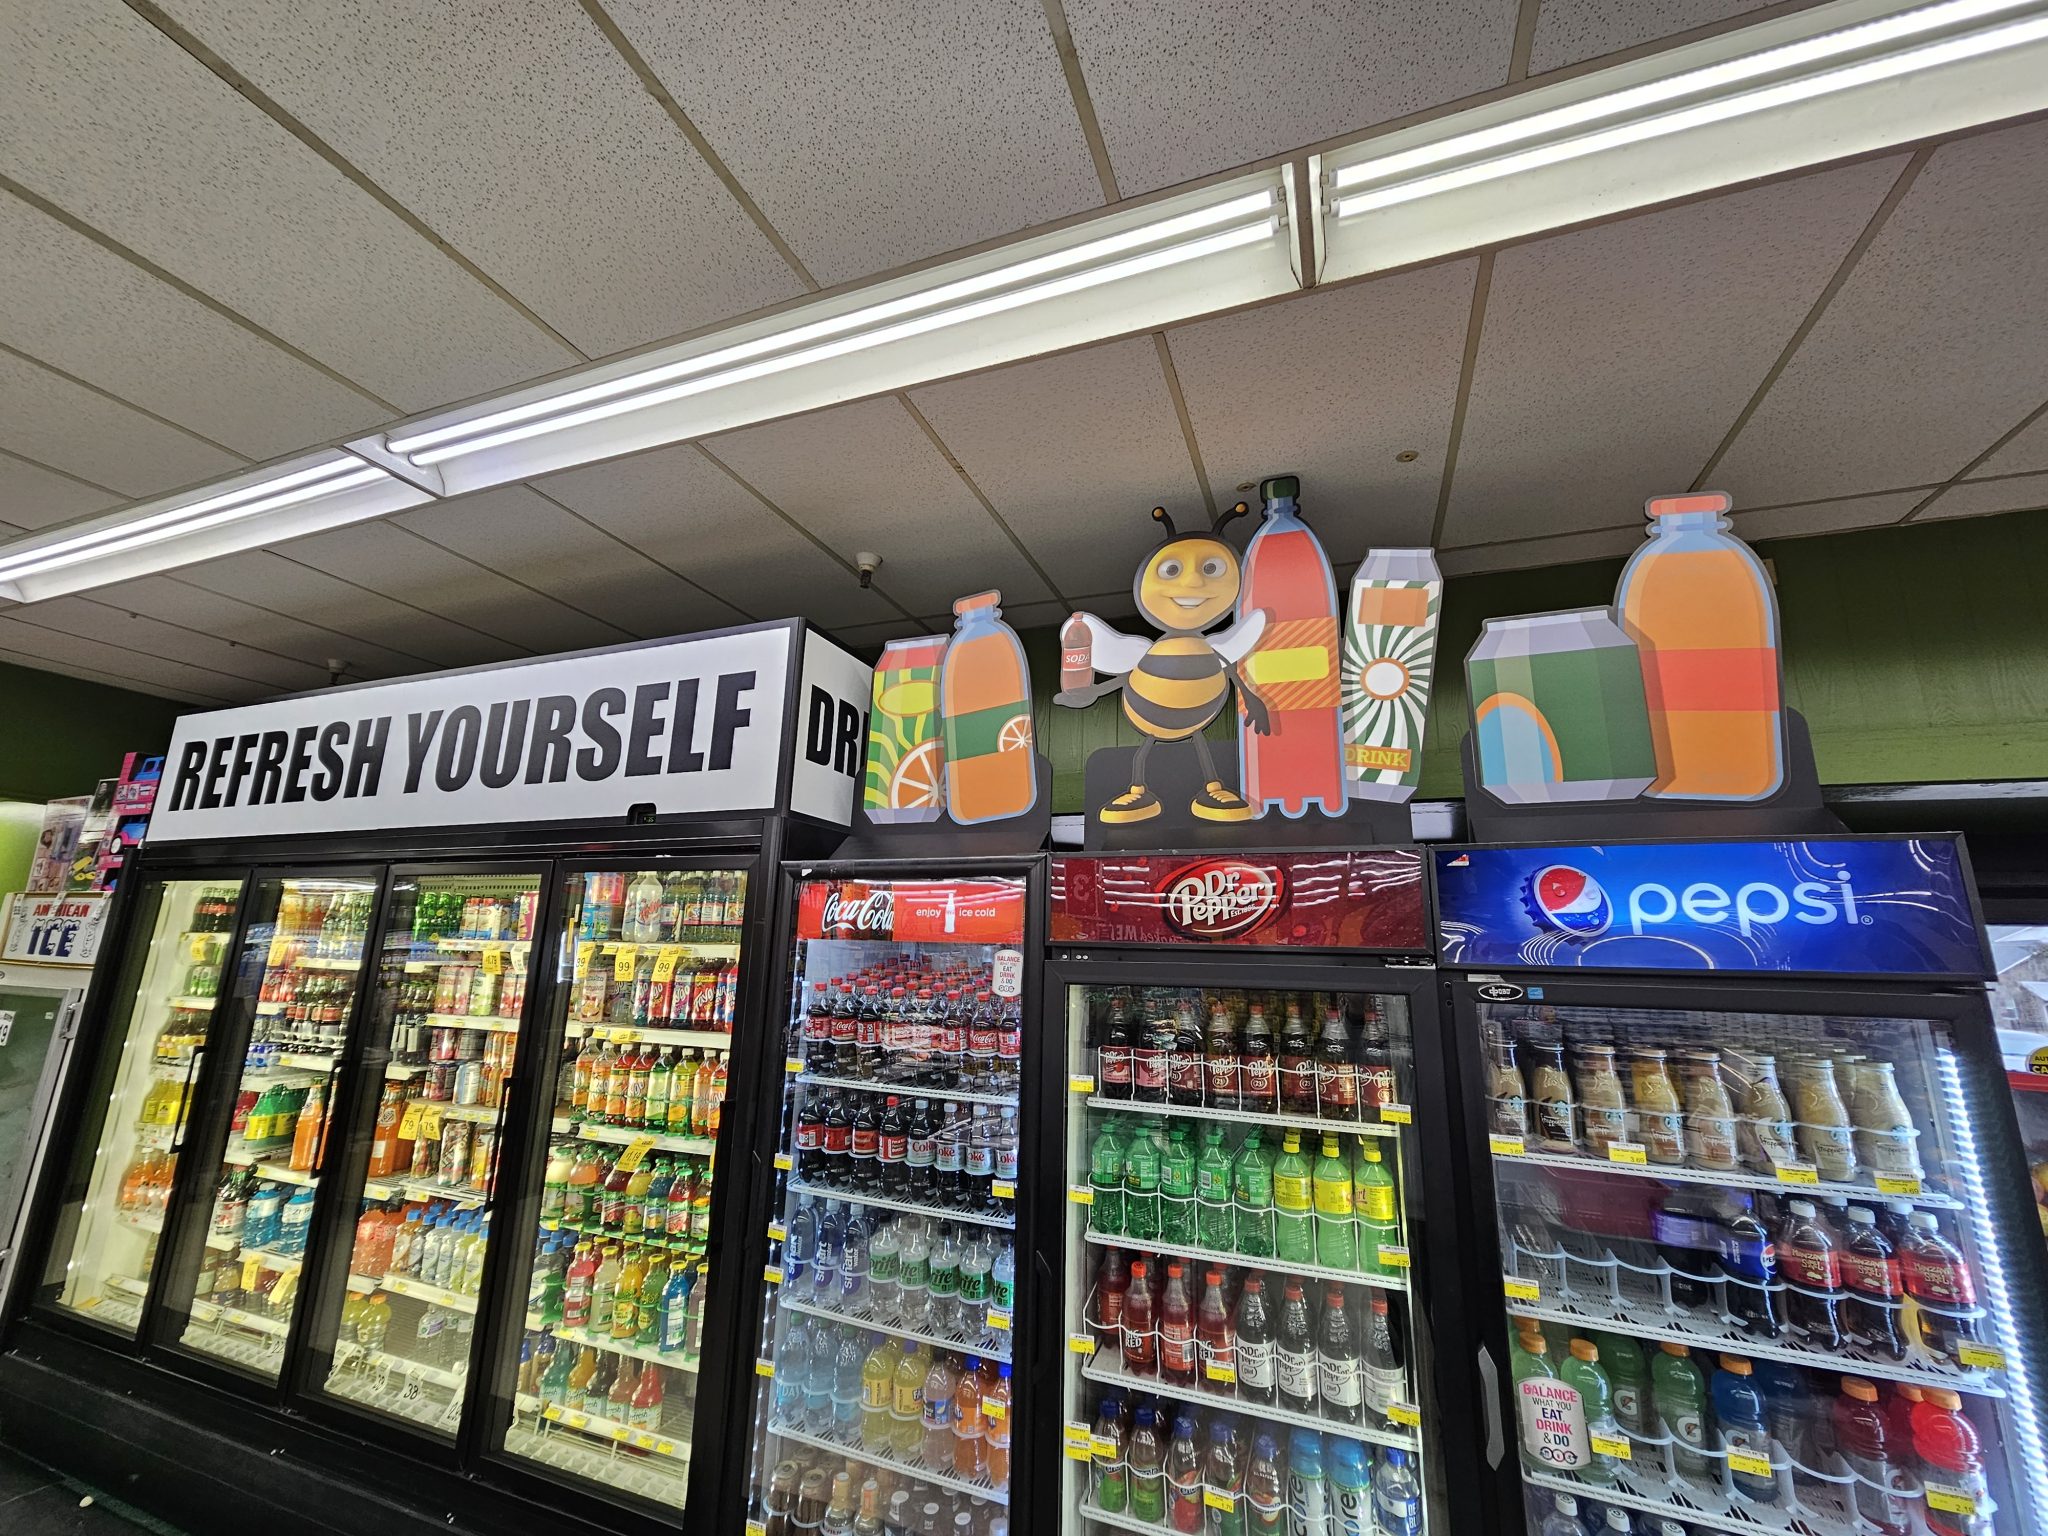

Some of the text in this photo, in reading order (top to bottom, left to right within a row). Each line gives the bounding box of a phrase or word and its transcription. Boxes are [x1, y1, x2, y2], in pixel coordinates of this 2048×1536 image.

[1065, 653, 1090, 663] SODA
[805, 684, 868, 780] DR
[167, 671, 757, 812] REFRESH YOURSELF
[1344, 747, 1408, 768] DRINK
[1204, 869, 1241, 897] Dr
[1170, 876, 1266, 927] Pepper
[1629, 870, 1859, 937] pepsi
[32, 903, 92, 918] AMRICAN
[821, 891, 895, 933] Coca-Cola
[916, 907, 996, 918] enjoy ice cold
[26, 917, 82, 958] ICE
[996, 955, 1021, 963] BALANCE
[617, 961, 631, 972] 99
[657, 962, 671, 973] 99
[999, 971, 1016, 979] DRINK
[938, 1145, 955, 1158] oke
[968, 1151, 985, 1163] oke
[1630, 1156, 1645, 1164] 3.69
[1800, 1176, 1818, 1184] 3.69
[1901, 1187, 1919, 1195] 3.69
[930, 1271, 953, 1286] rite
[960, 1275, 982, 1291] rite
[1125, 1337, 1143, 1349] RED
[1522, 1383, 1578, 1403] BALANCE
[1531, 1397, 1572, 1411] WHAT YOU
[1535, 1418, 1573, 1436] DRINK
[1543, 1432, 1570, 1447] & DO
[1613, 1448, 1629, 1458] 2.19
[1752, 1466, 1770, 1476] 2.19
